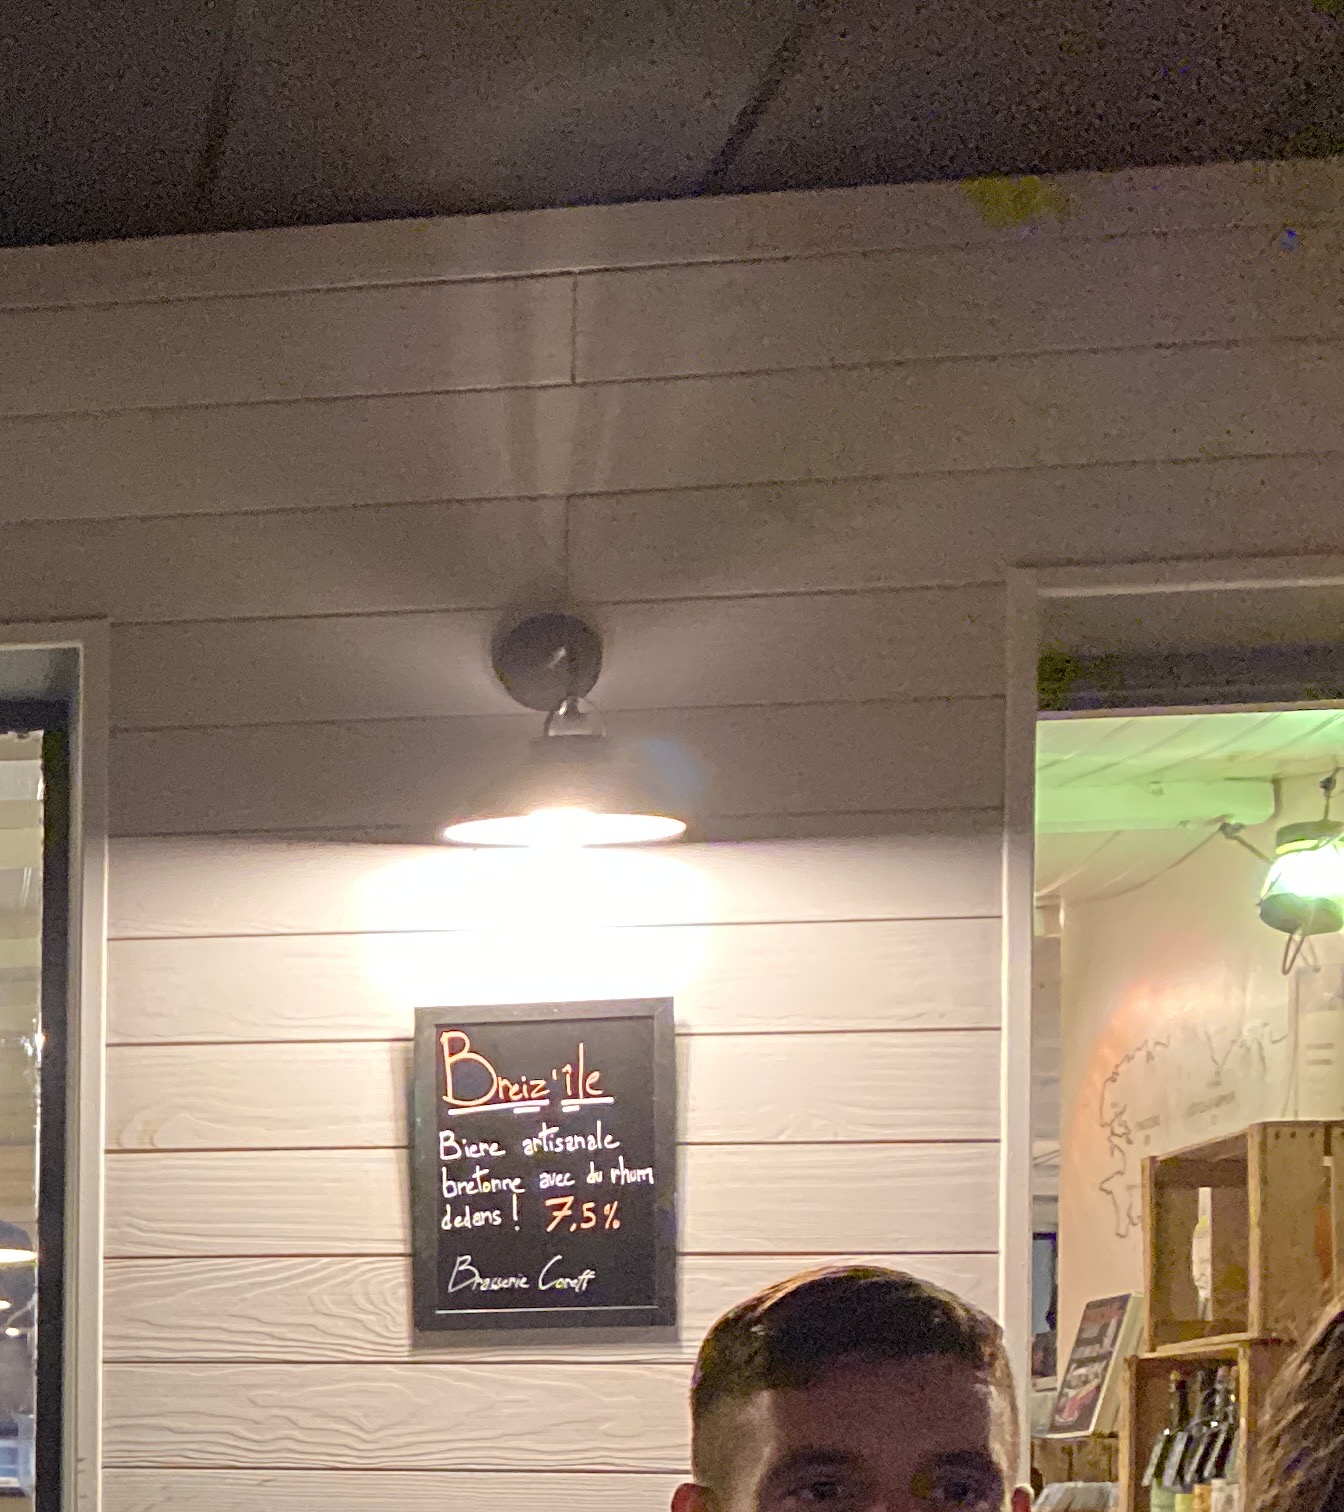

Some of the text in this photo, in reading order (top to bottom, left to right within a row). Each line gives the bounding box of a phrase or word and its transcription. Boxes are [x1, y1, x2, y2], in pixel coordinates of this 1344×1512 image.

[522, 1120, 621, 1155] artisanale
[441, 1155, 654, 1198] bretonne avec du rhum
[441, 1203, 502, 1231] dedans
[448, 1255, 529, 1293] Brasserie
